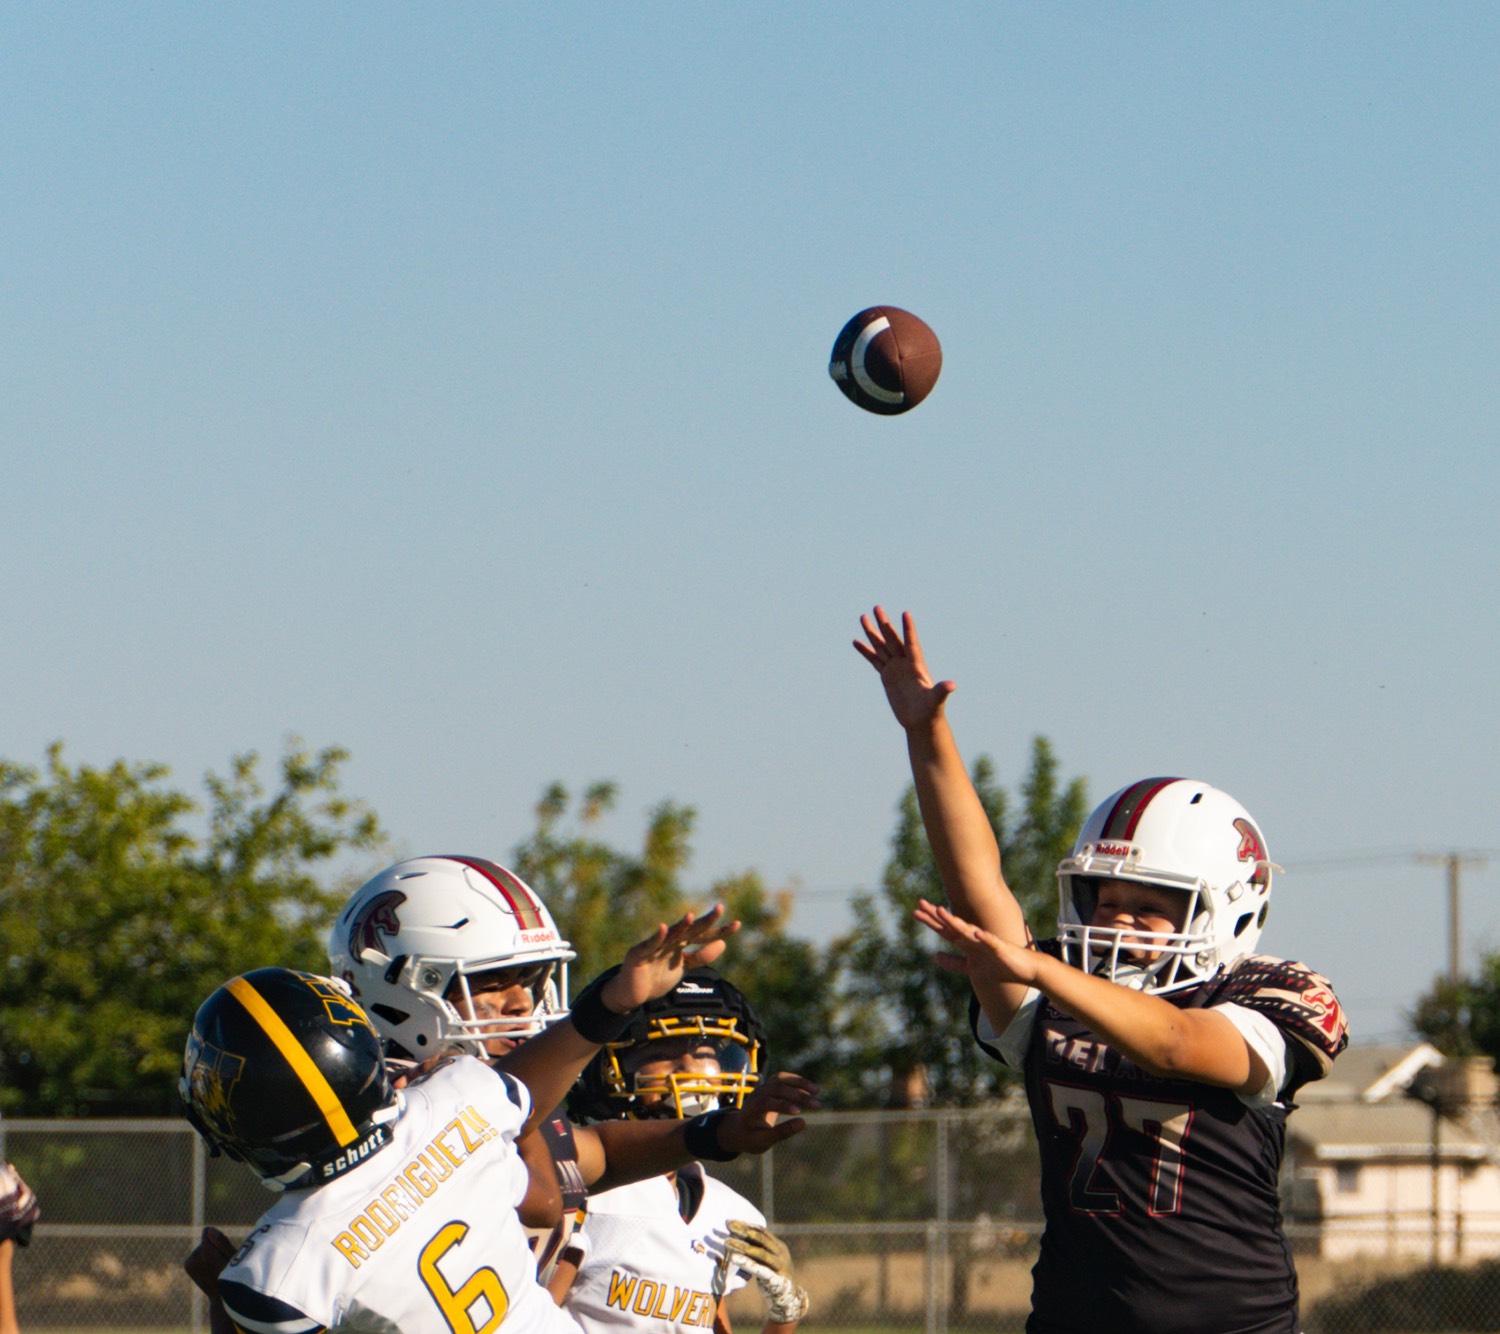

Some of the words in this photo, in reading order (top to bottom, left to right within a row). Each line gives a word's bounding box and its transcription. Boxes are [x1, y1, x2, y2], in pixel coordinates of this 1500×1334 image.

[1096, 843, 1130, 856] Riddell
[323, 1128, 384, 1177] schutt
[331, 1105, 498, 1270] RODRIGUEZ!!
[1043, 1078, 1194, 1218] 27
